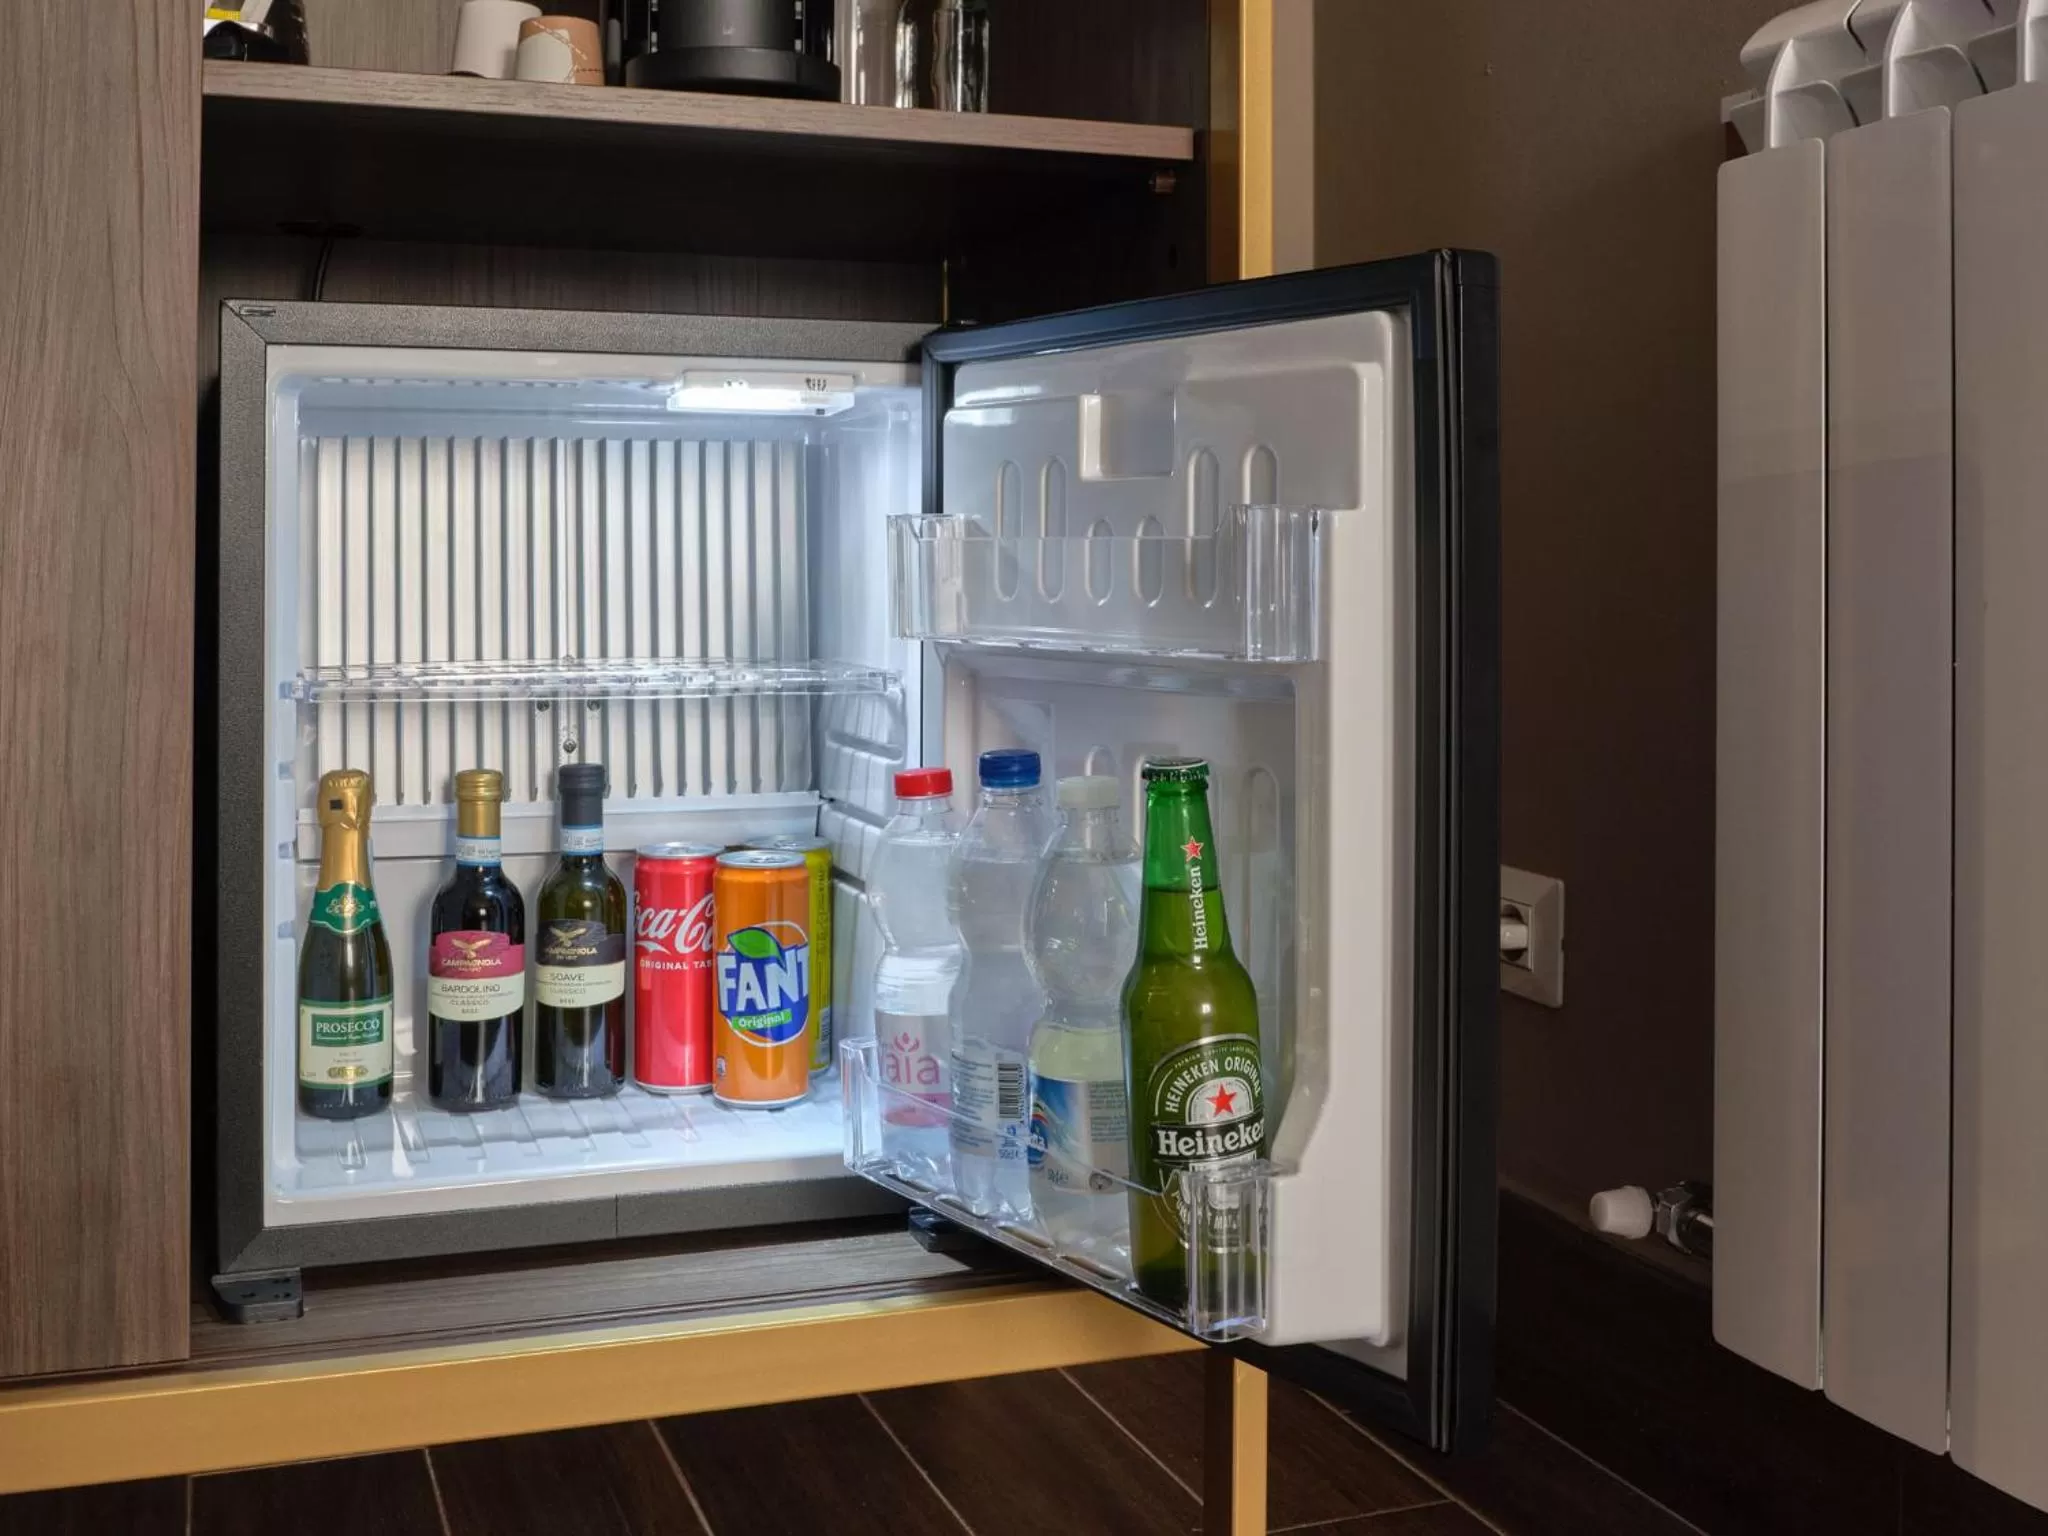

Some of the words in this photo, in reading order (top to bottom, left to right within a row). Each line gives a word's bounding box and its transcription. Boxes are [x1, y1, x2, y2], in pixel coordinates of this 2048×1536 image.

[1189, 866, 1208, 949] Heineken
[640, 959, 688, 970] ORIGINAL
[441, 983, 501, 994] BARDOLINO
[316, 1018, 381, 1034] PROSECCO
[738, 1013, 785, 1028] Original
[1164, 1058, 1220, 1113] HEINEKEN
[1224, 1056, 1262, 1097] ORIGINAL
